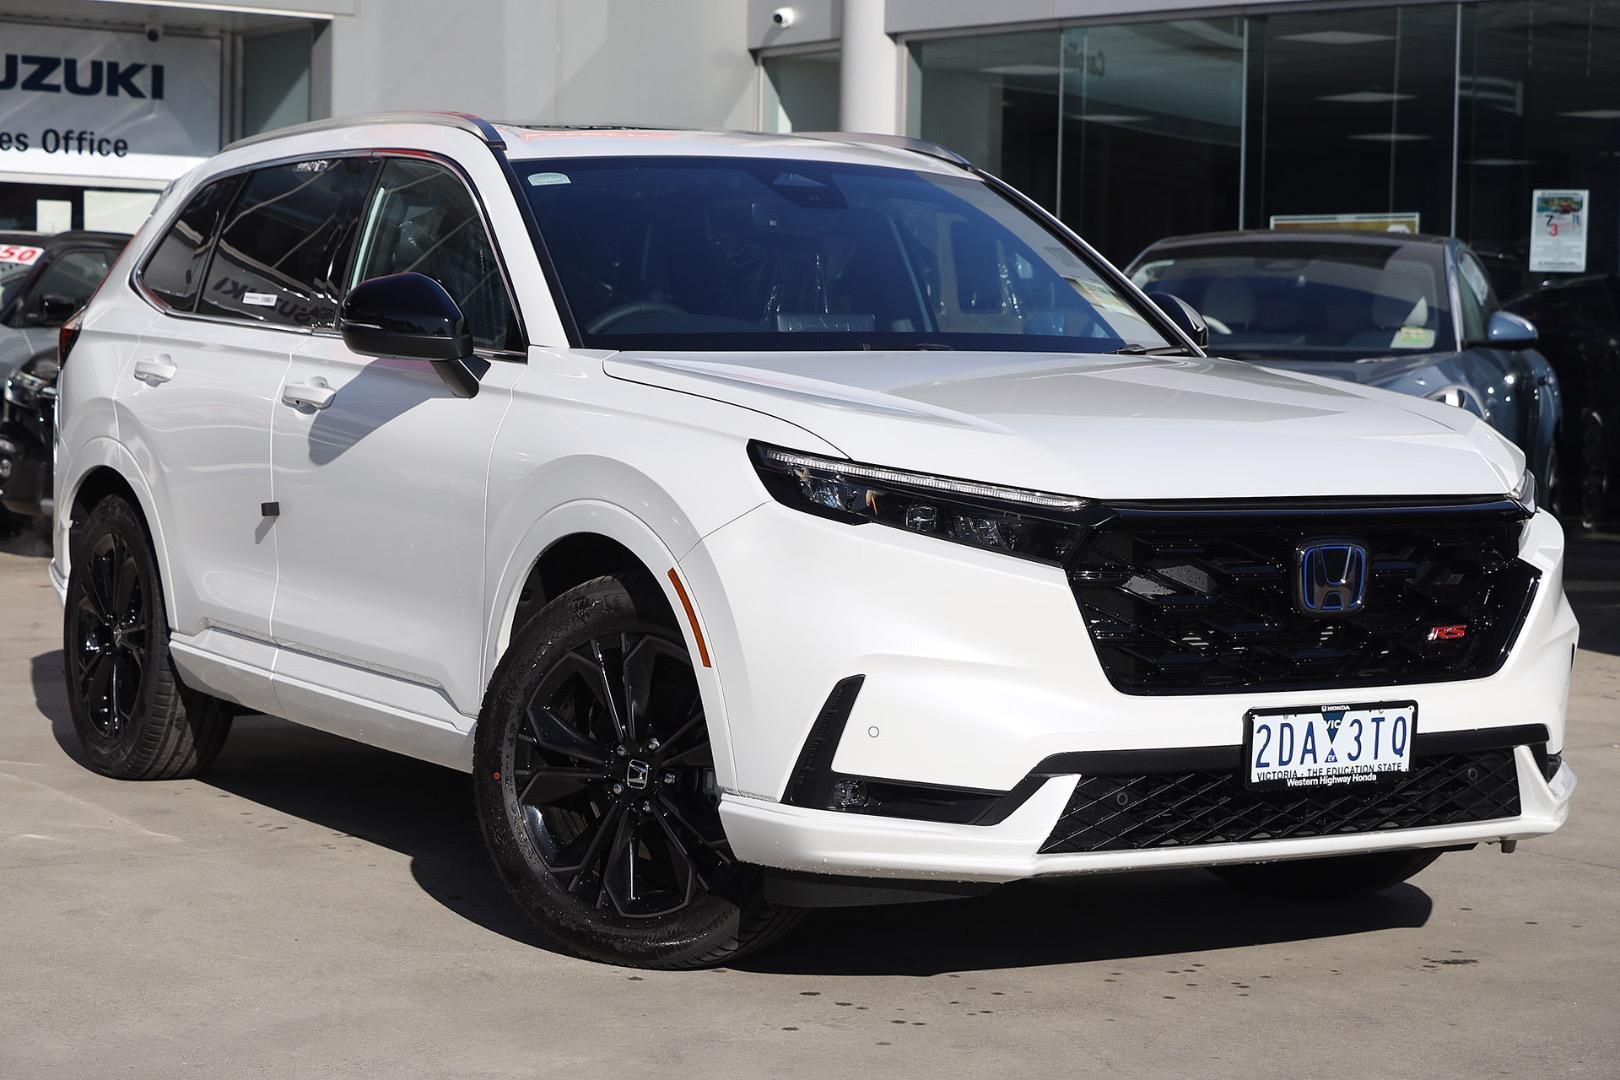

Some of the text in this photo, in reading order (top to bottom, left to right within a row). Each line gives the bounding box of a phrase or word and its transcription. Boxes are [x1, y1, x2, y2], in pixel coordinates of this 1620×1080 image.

[0, 128, 128, 157] es Office
[1255, 716, 1407, 768] 2DA 3TQ
[1257, 770, 1298, 781] VICTORIA
[1307, 768, 1323, 776] THE
[1327, 764, 1375, 776] EDUCATION
[1378, 762, 1402, 771] STATE
[1286, 773, 1377, 787] Western Highway Honda
